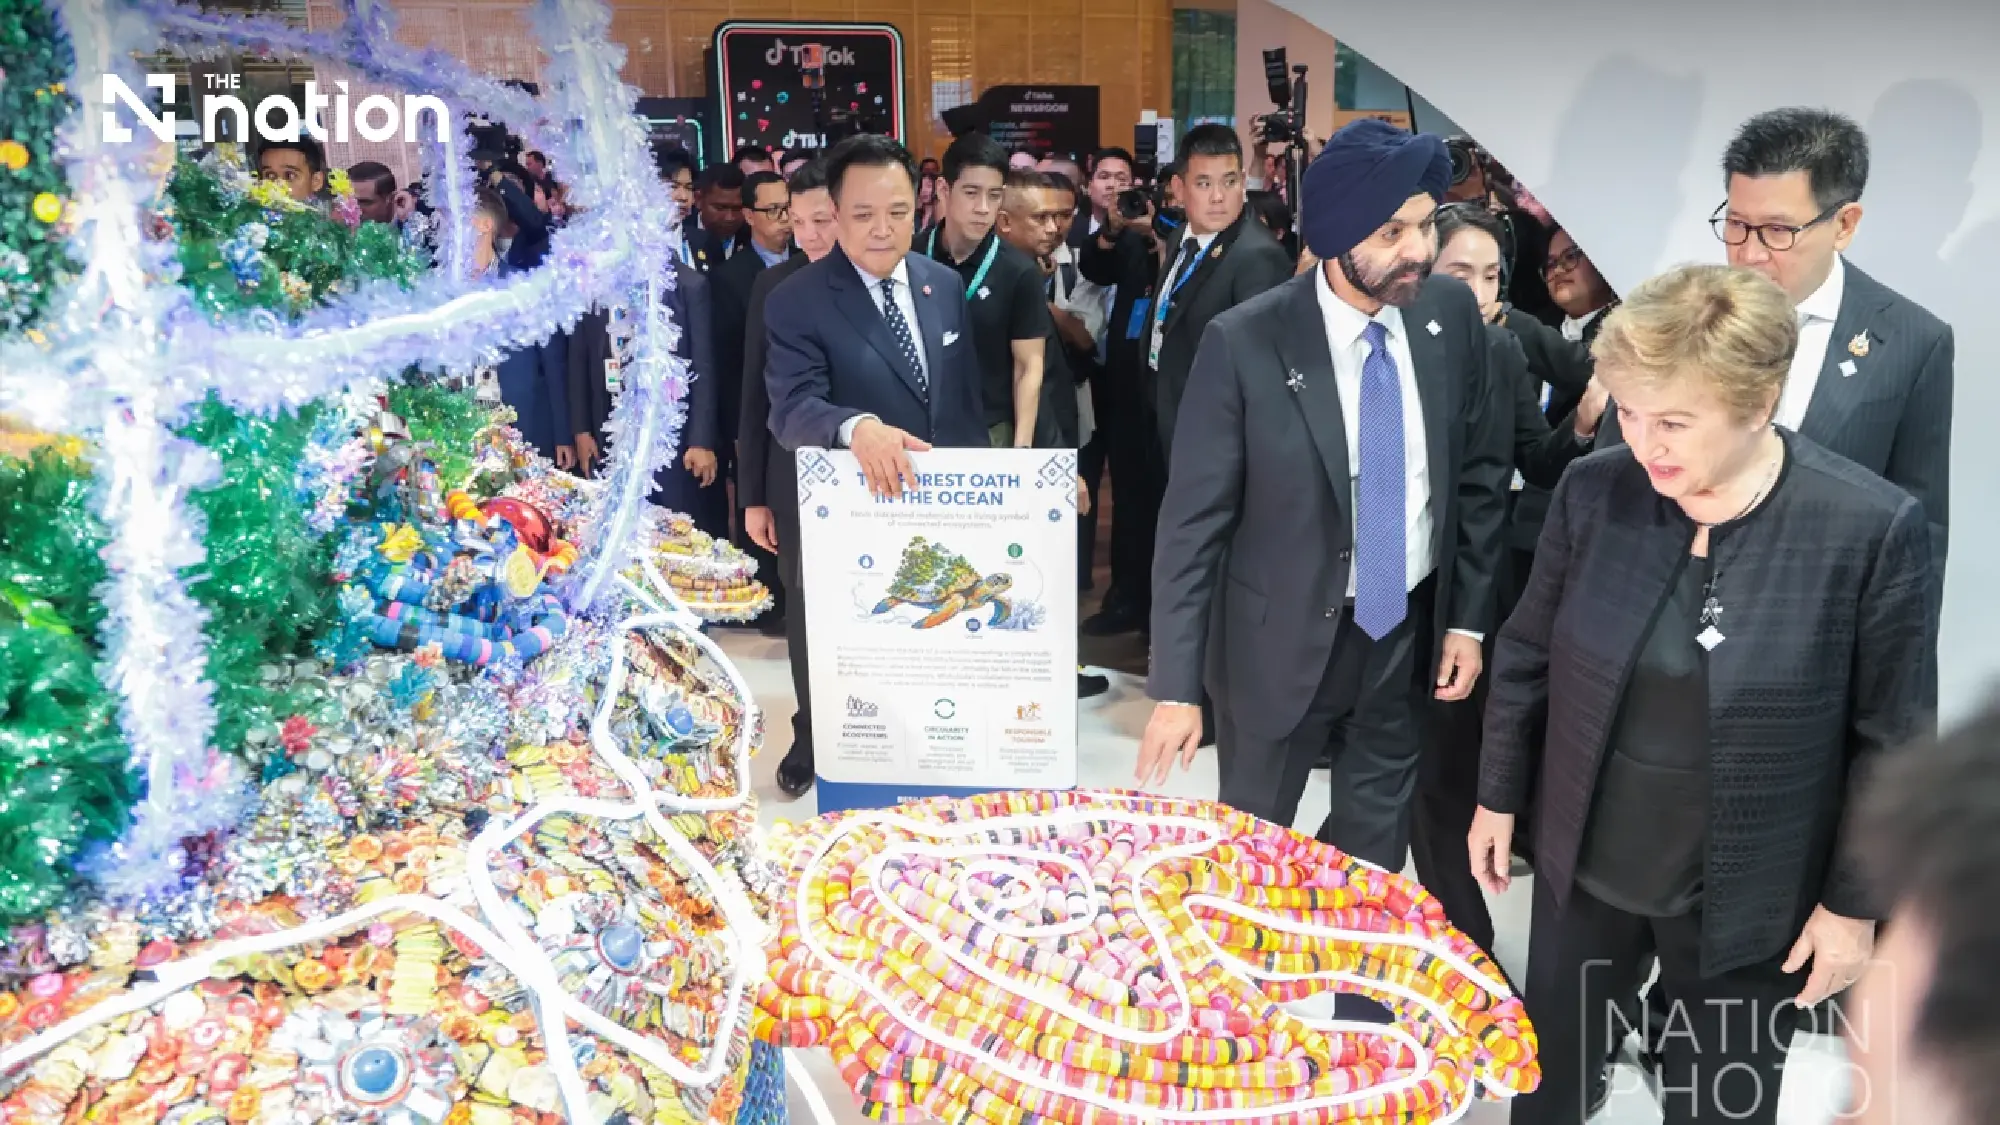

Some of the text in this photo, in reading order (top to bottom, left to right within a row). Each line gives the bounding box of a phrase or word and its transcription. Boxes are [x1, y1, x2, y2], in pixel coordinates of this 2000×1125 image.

[789, 46, 855, 65] TTok
[1010, 103, 1069, 113] NEWSROOM
[970, 473, 1020, 488] OATH
[901, 491, 933, 505] THE
[937, 491, 1003, 506] OCEAN
